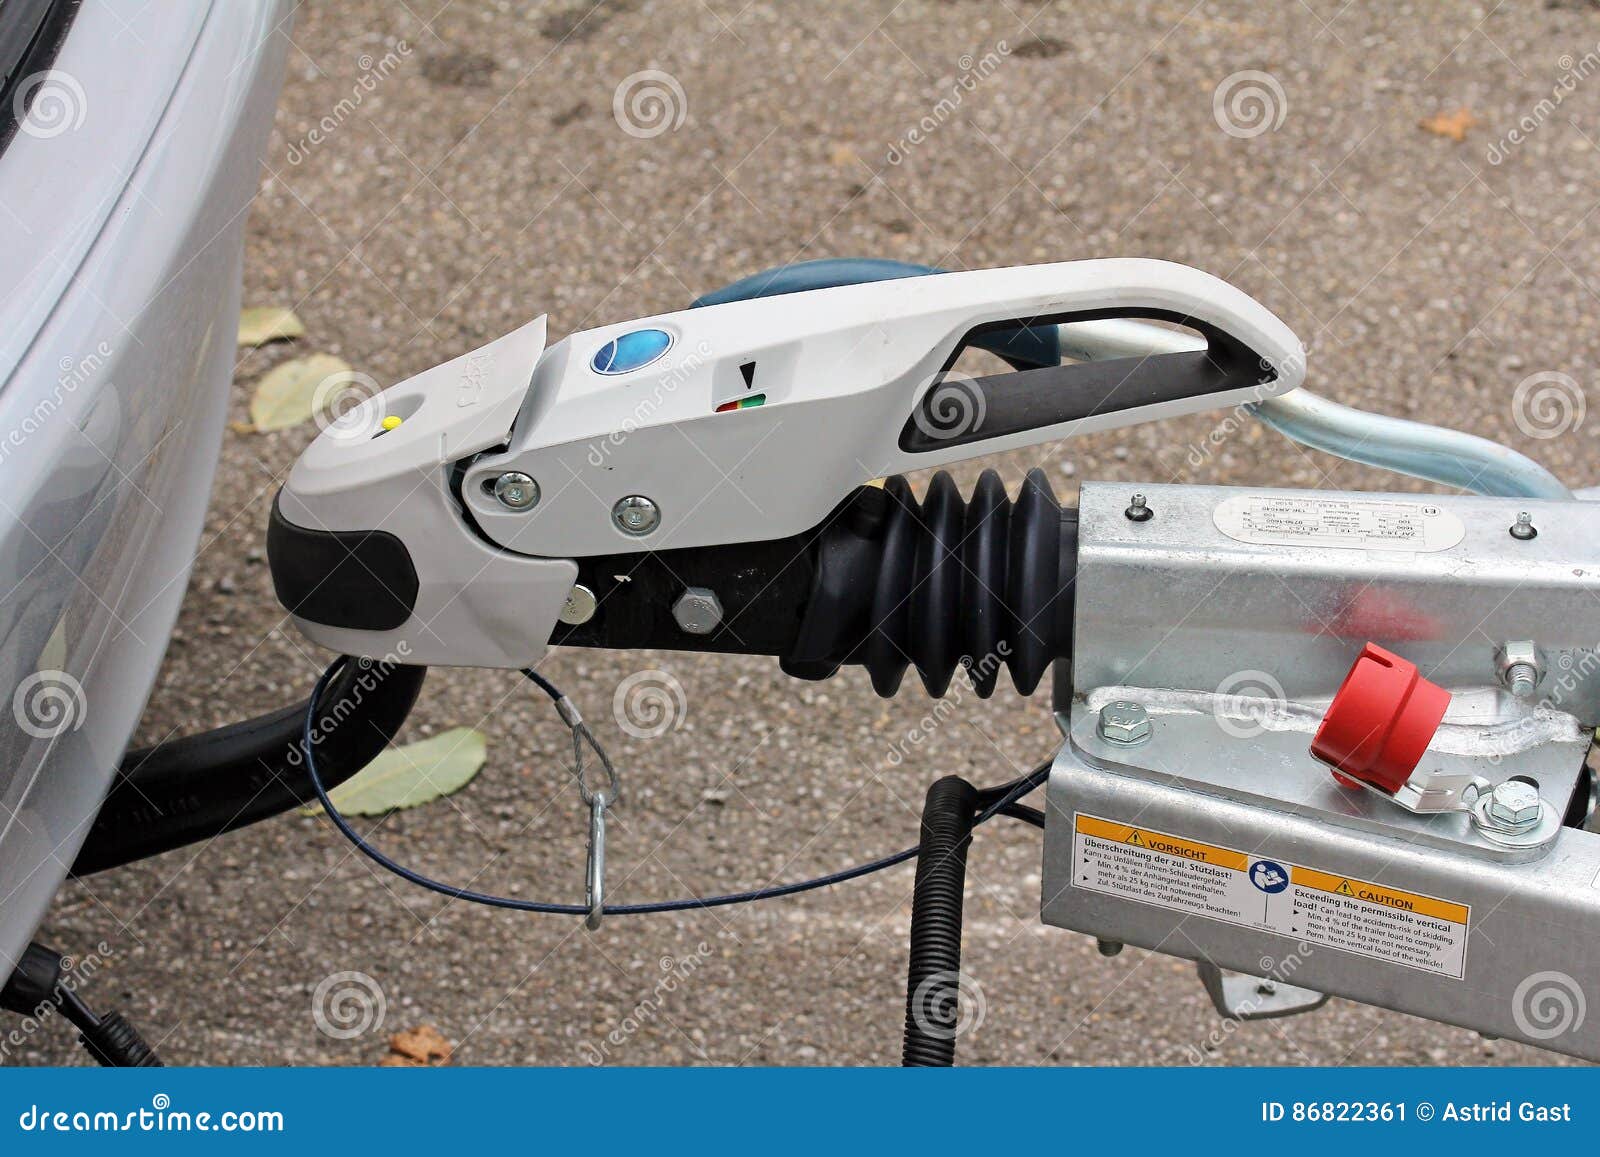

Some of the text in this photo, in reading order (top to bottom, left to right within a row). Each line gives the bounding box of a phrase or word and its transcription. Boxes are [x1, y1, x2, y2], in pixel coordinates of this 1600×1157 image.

[1083, 848, 1102, 858] Kann
[1113, 855, 1143, 868] Unfällen
[1084, 837, 1232, 880] Überschreitung der zul. Stützlast!
[1149, 839, 1207, 861] VORSICHT
[1097, 870, 1208, 902] mehr als 25 kg nicht notwendig
[1130, 868, 1142, 877] der
[1143, 870, 1190, 888] Anhängerlast
[1191, 883, 1227, 897] einhalten.
[1111, 881, 1142, 895] Stützlast
[1143, 889, 1155, 898] des
[1157, 891, 1205, 910] Zugfahrzeugs
[1205, 903, 1241, 917] beachten!
[1294, 888, 1451, 933] Exceeding the permissible vertical
[1358, 890, 1413, 910] CAUTION
[1293, 898, 1455, 945] load! Can lead to accidents-risk of skidding.
[1307, 912, 1322, 921] Min.
[1341, 920, 1349, 928] of
[1351, 922, 1363, 931] the
[1364, 926, 1386, 937] trailer
[1387, 931, 1404, 941] load
[1307, 921, 1327, 931] more
[1328, 926, 1345, 936] than
[1346, 930, 1356, 938] 25
[1367, 936, 1380, 944] are
[1381, 939, 1394, 948] not
[1305, 929, 1325, 939] Perm.
[1327, 935, 1346, 944] Note
[1346, 938, 1373, 951] vertical
[1374, 945, 1391, 956] load
[1401, 953, 1414, 962] the
[1415, 956, 1443, 969] vehicle!
